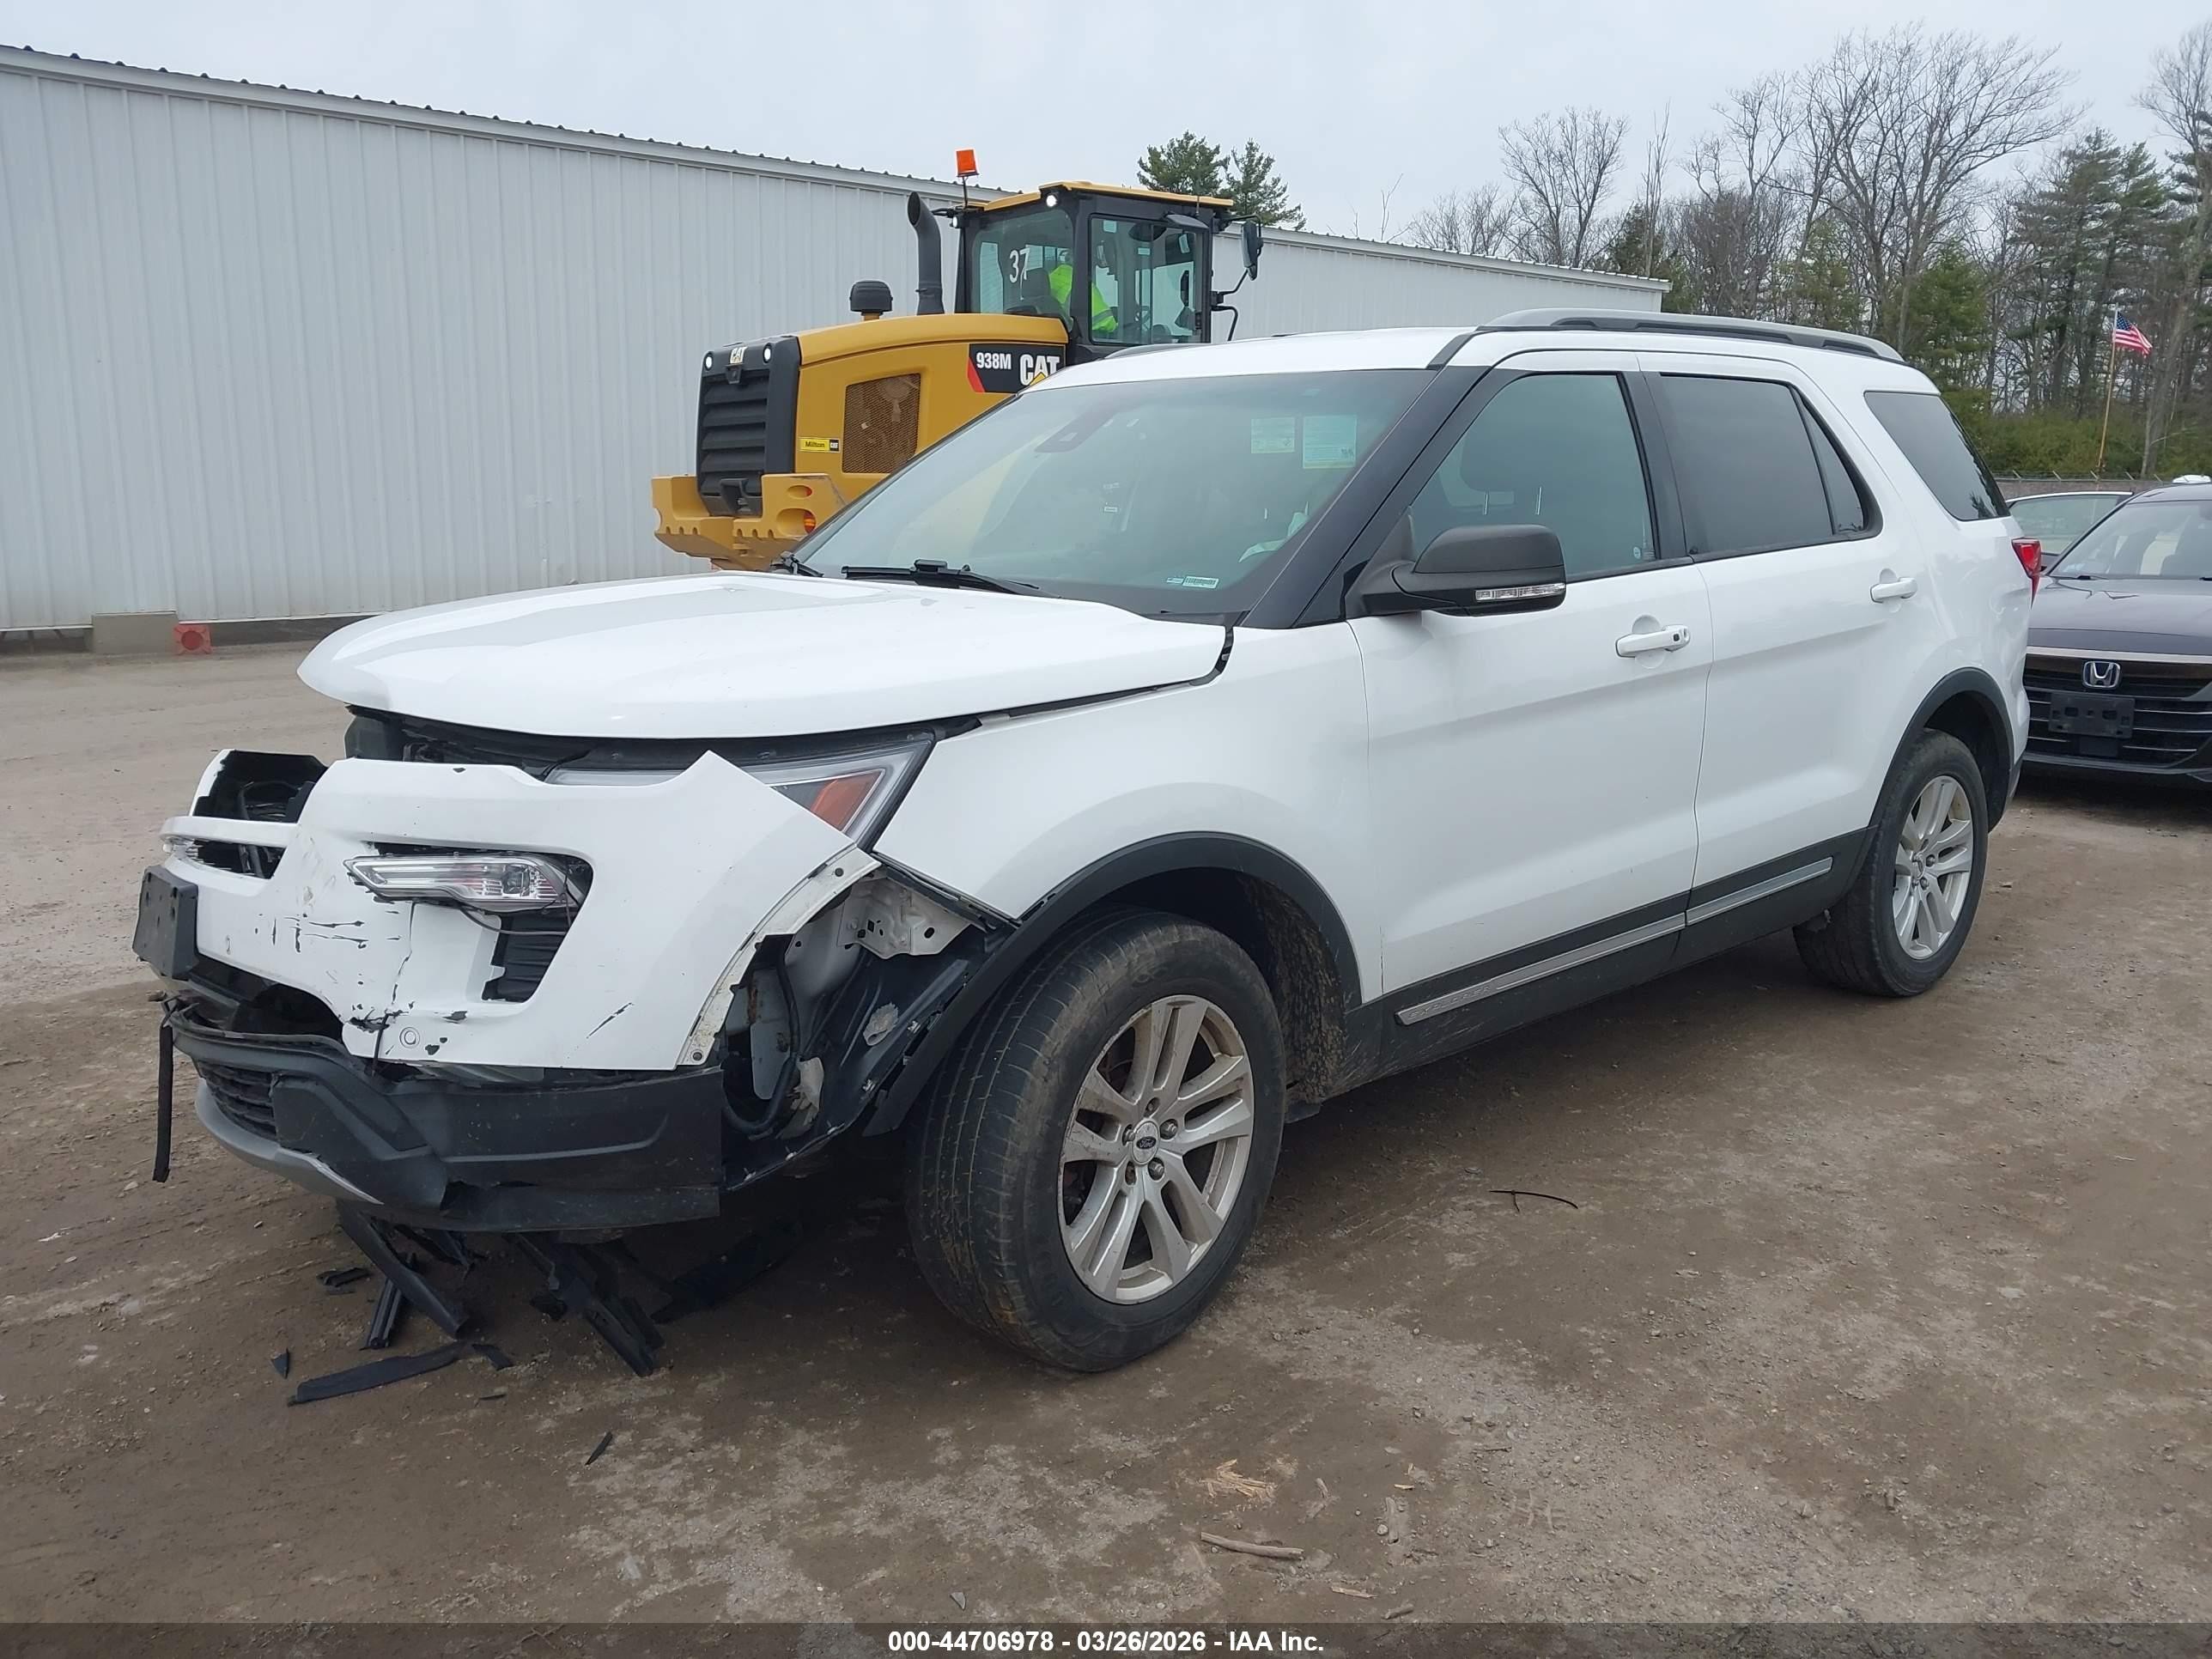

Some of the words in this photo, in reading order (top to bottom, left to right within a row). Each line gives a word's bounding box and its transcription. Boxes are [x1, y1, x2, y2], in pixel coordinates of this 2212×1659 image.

[1009, 247, 1030, 283] 37
[975, 352, 1012, 370] 938M
[1019, 354, 1060, 386] CAT
